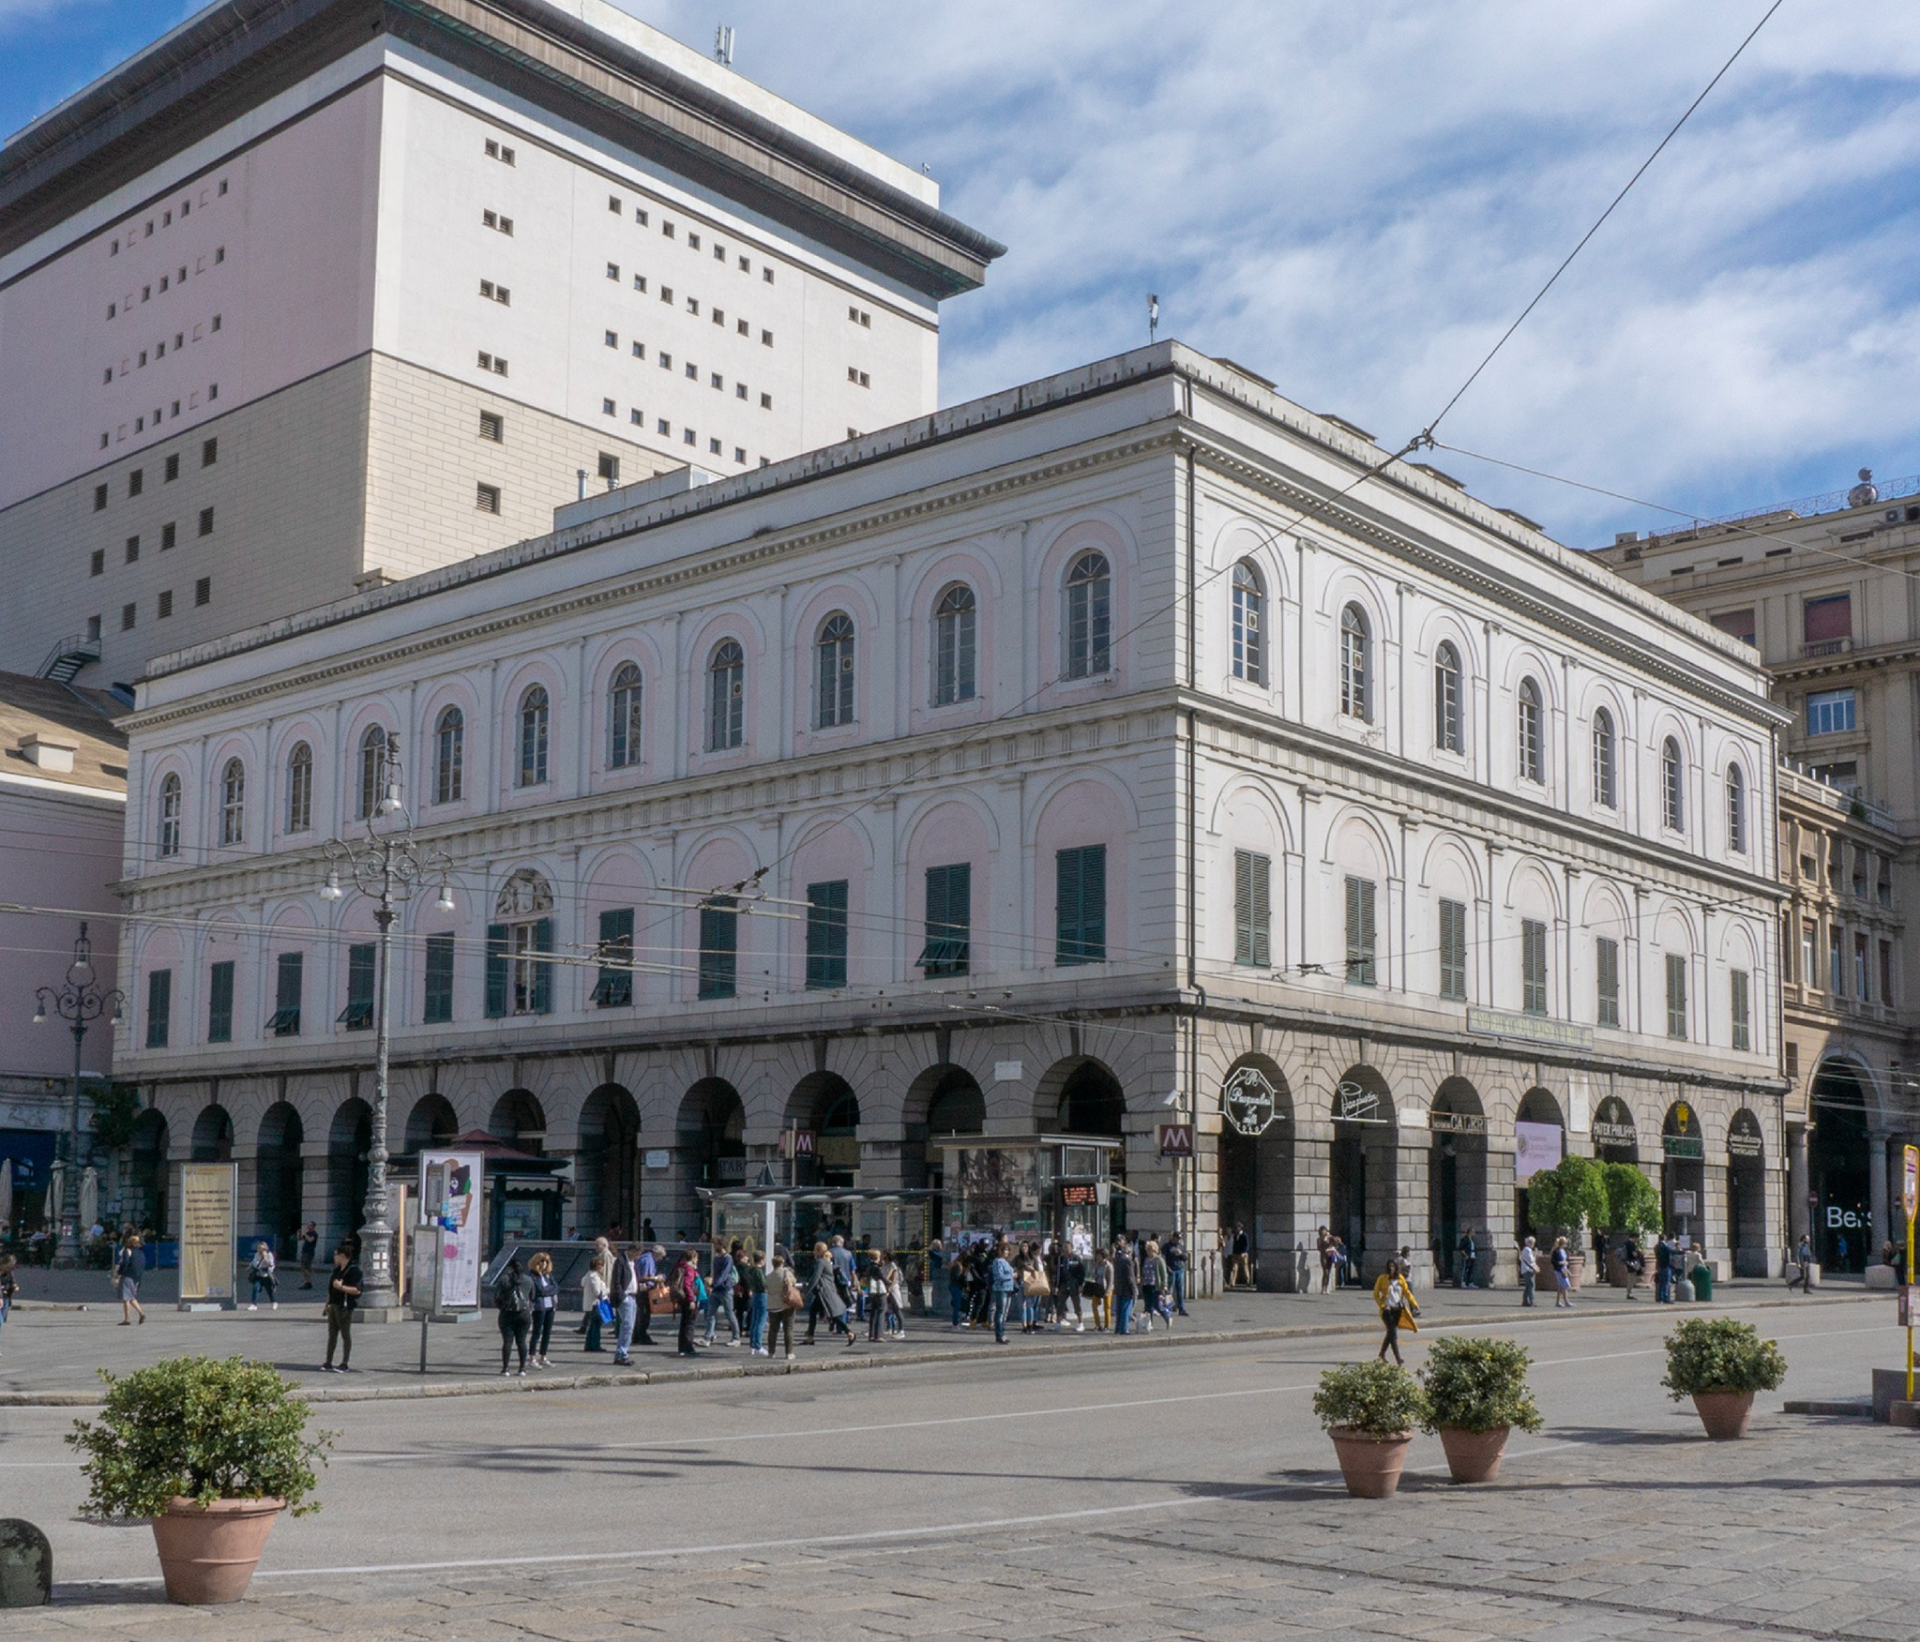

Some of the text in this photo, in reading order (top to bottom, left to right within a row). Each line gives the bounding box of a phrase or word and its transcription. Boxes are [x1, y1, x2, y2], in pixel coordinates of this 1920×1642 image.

[1162, 1128, 1190, 1148] M
[1593, 1122, 1636, 1138] PATEK PHILIPPE
[796, 1134, 813, 1152] M
